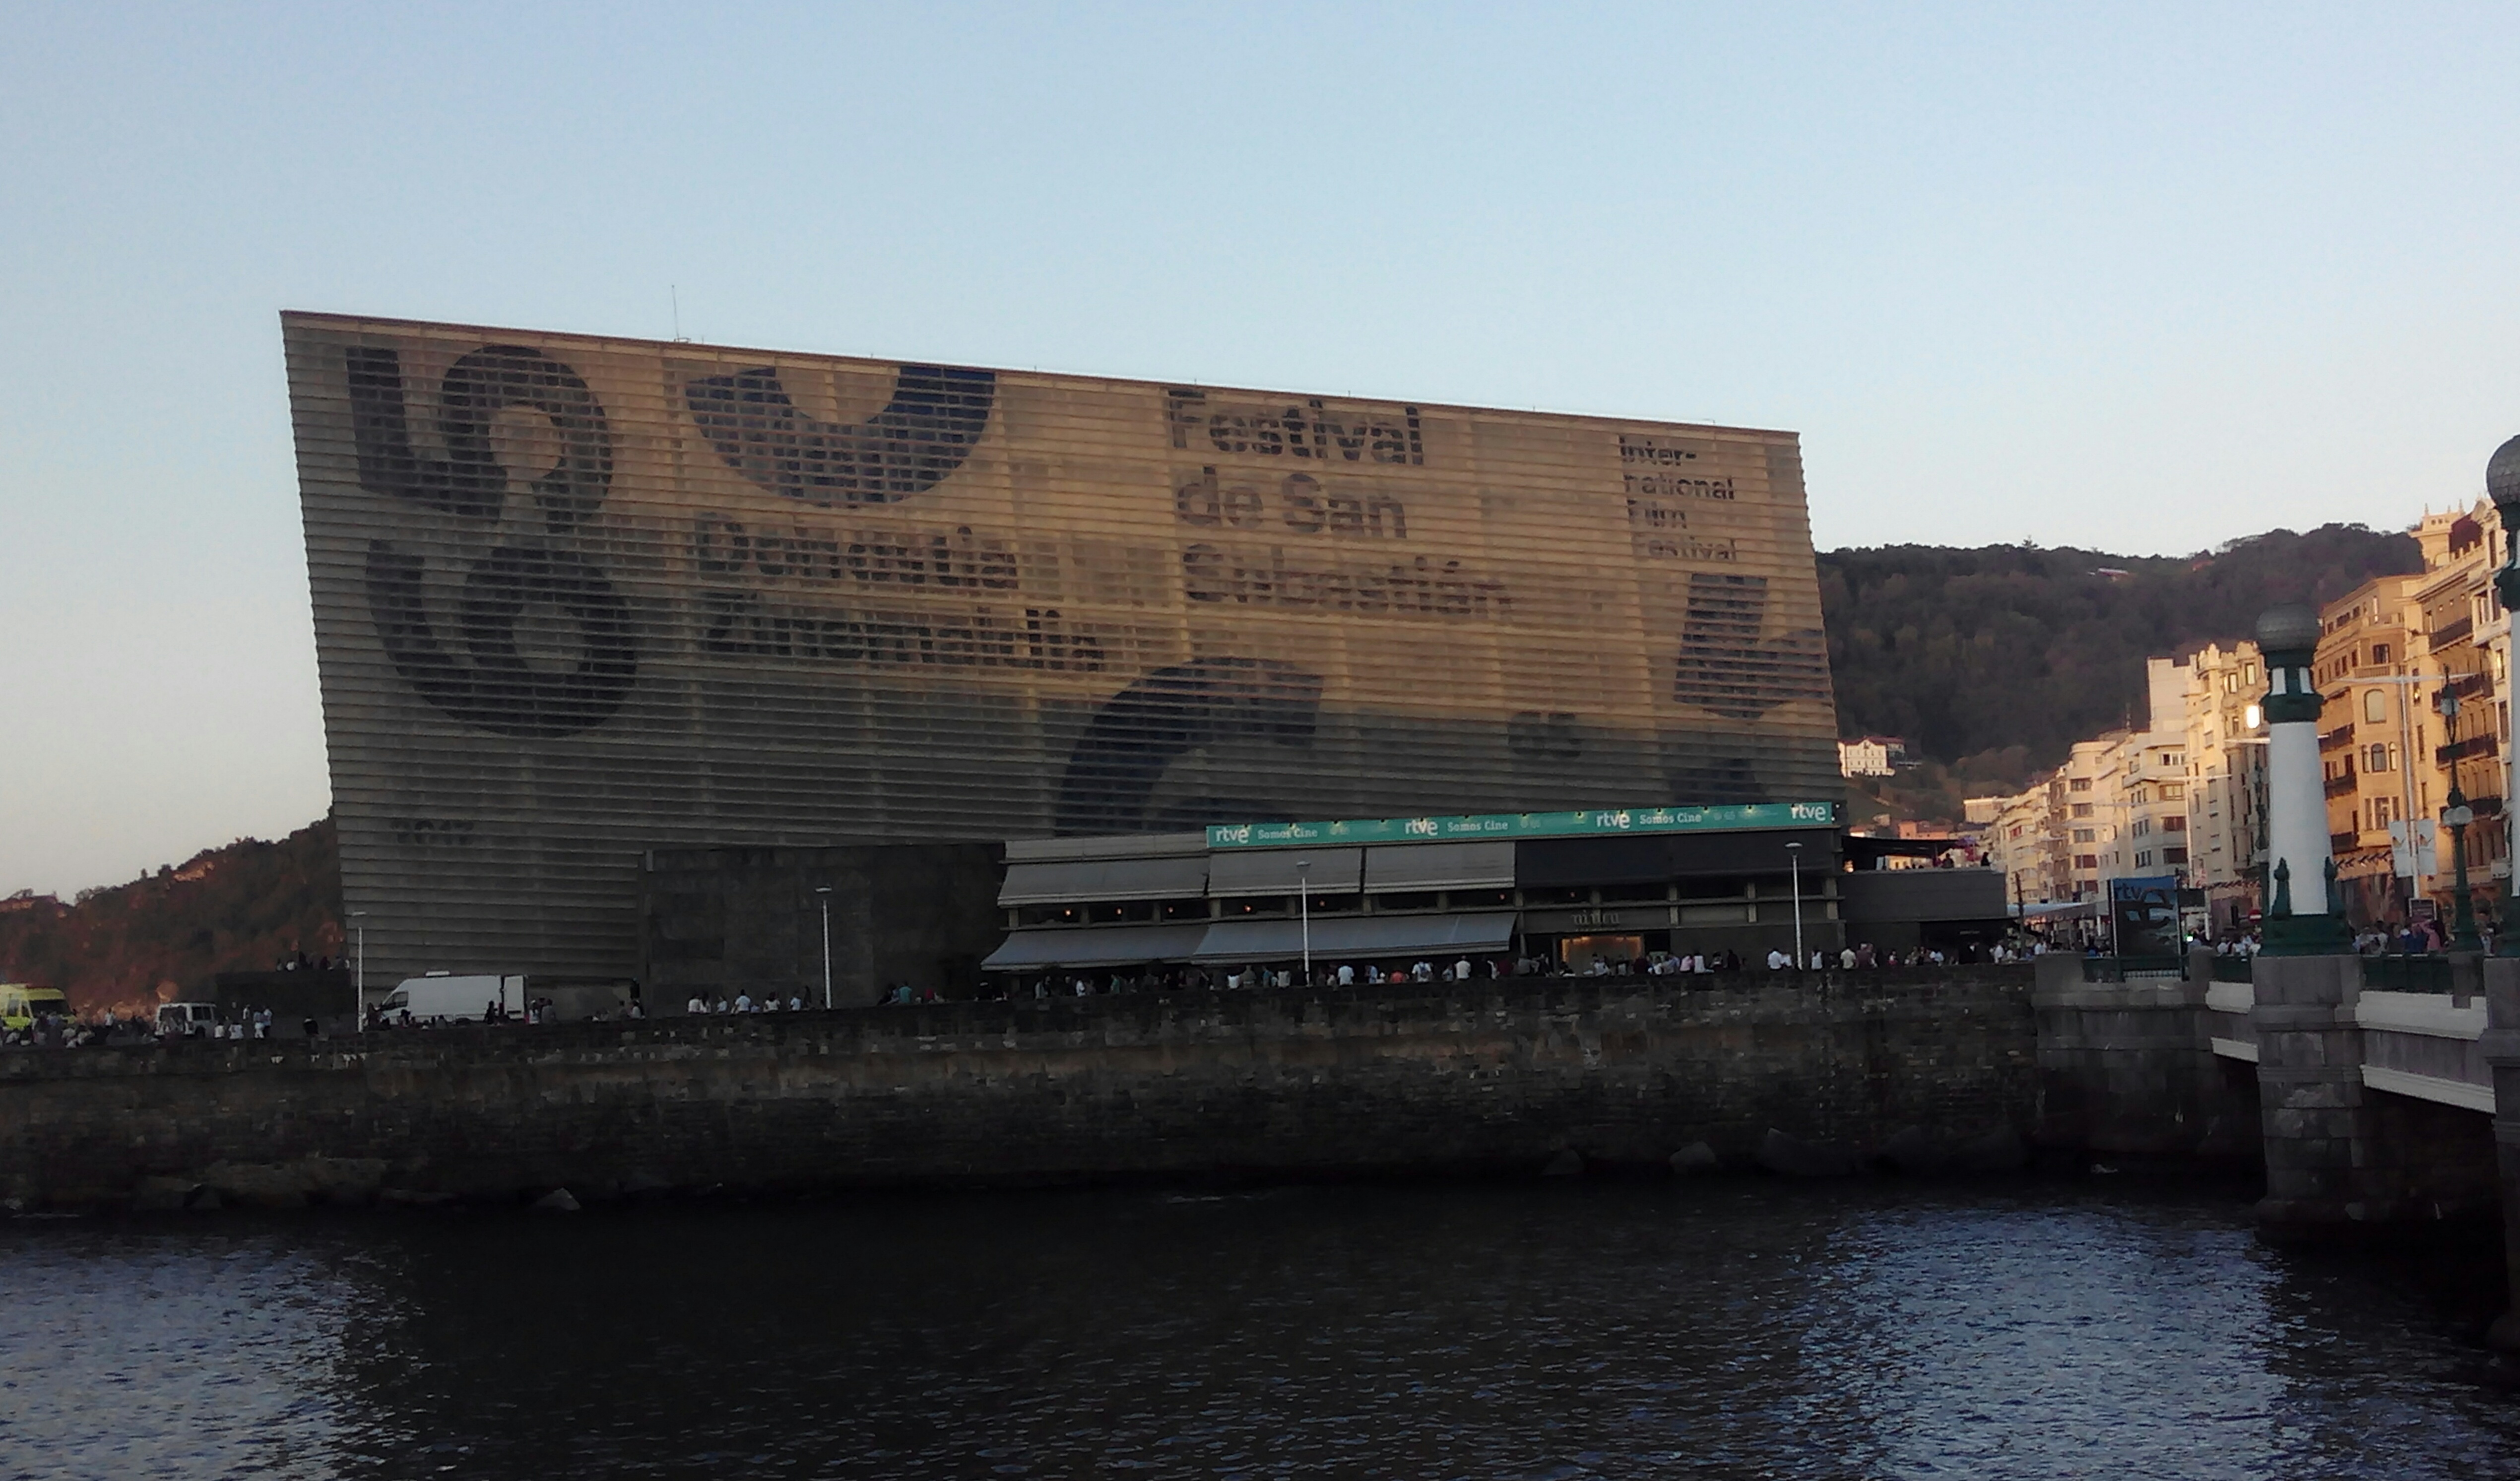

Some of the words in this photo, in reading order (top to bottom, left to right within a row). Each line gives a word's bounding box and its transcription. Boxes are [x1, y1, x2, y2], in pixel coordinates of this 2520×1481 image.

[1168, 389, 1424, 465] Festival
[1177, 466, 1263, 529] de
[1281, 473, 1408, 540] San
[697, 510, 1020, 590] Donostia
[699, 591, 1104, 672] Zinemaldia
[1215, 827, 1249, 843] rtve
[1257, 829, 1291, 840] Somos
[1293, 827, 1318, 838] Cine
[1404, 819, 1438, 836] rtve
[1447, 821, 1482, 833] Somos
[1484, 820, 1508, 831] Cine
[1596, 812, 1631, 829] rtve
[1639, 814, 1675, 825] Somos
[1677, 812, 1702, 823] Cine
[1791, 803, 1826, 822] rtve
